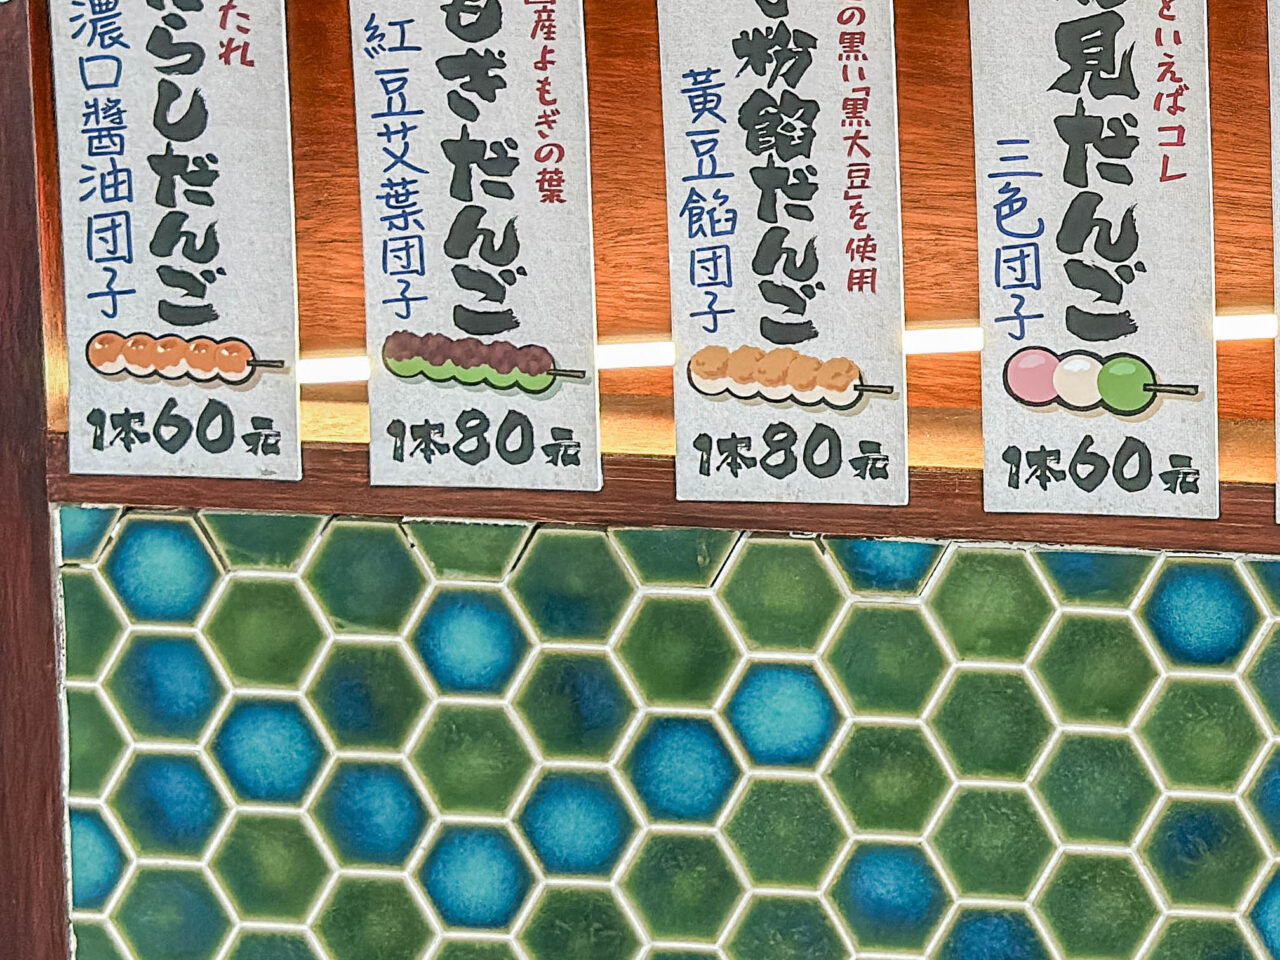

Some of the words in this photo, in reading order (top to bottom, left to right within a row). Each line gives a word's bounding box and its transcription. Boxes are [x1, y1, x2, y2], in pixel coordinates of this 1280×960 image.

[363, 13, 430, 320] 紅豆艾葉団子
[987, 139, 1045, 341] 三色団子
[86, 397, 281, 456] 1本60元
[386, 407, 581, 467] 1本80元
[692, 421, 890, 481] 1本80元
[1001, 434, 1200, 495] 1本60元
